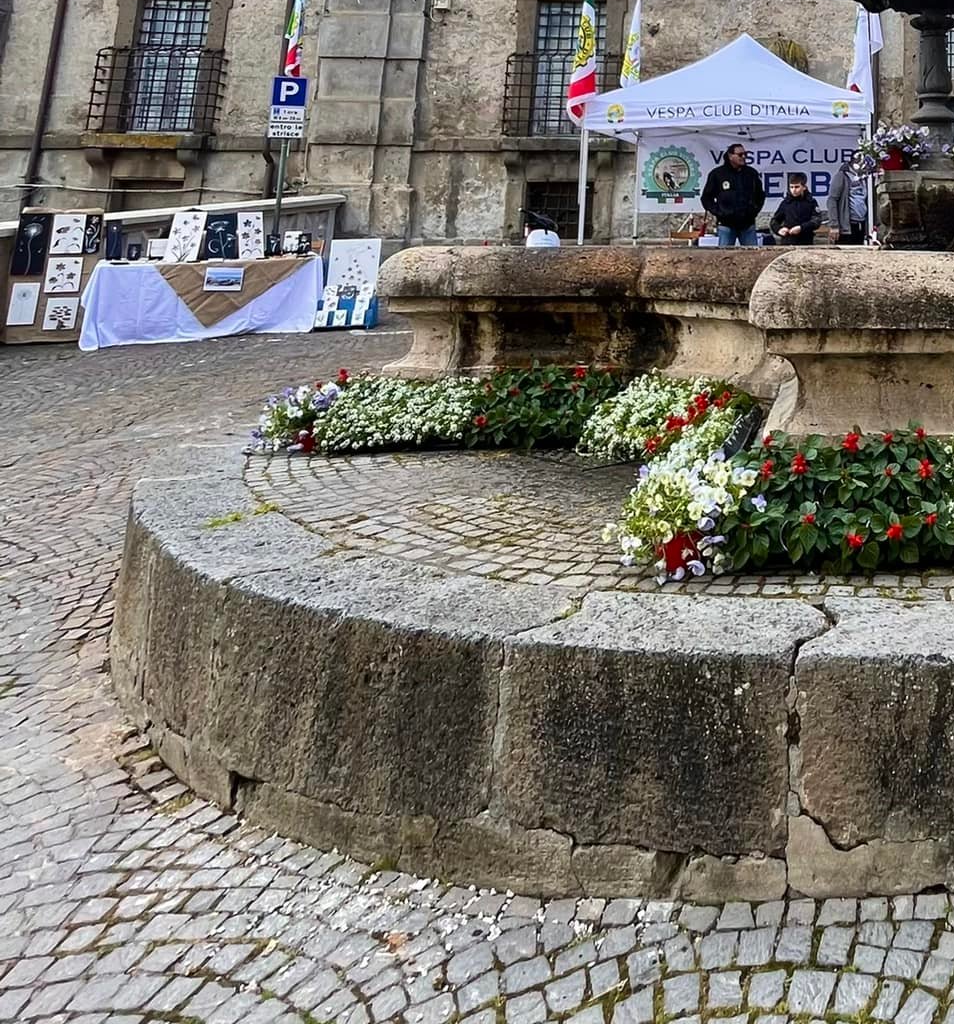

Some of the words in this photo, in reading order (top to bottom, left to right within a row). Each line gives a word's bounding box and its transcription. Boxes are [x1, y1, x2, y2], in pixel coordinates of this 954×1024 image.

[280, 81, 299, 102] P
[647, 106, 695, 118] VESPA
[703, 104, 742, 116] CLUB
[750, 104, 810, 116] D'ITALIA
[710, 149, 785, 164] VSPA
[792, 148, 854, 164] CLUB
